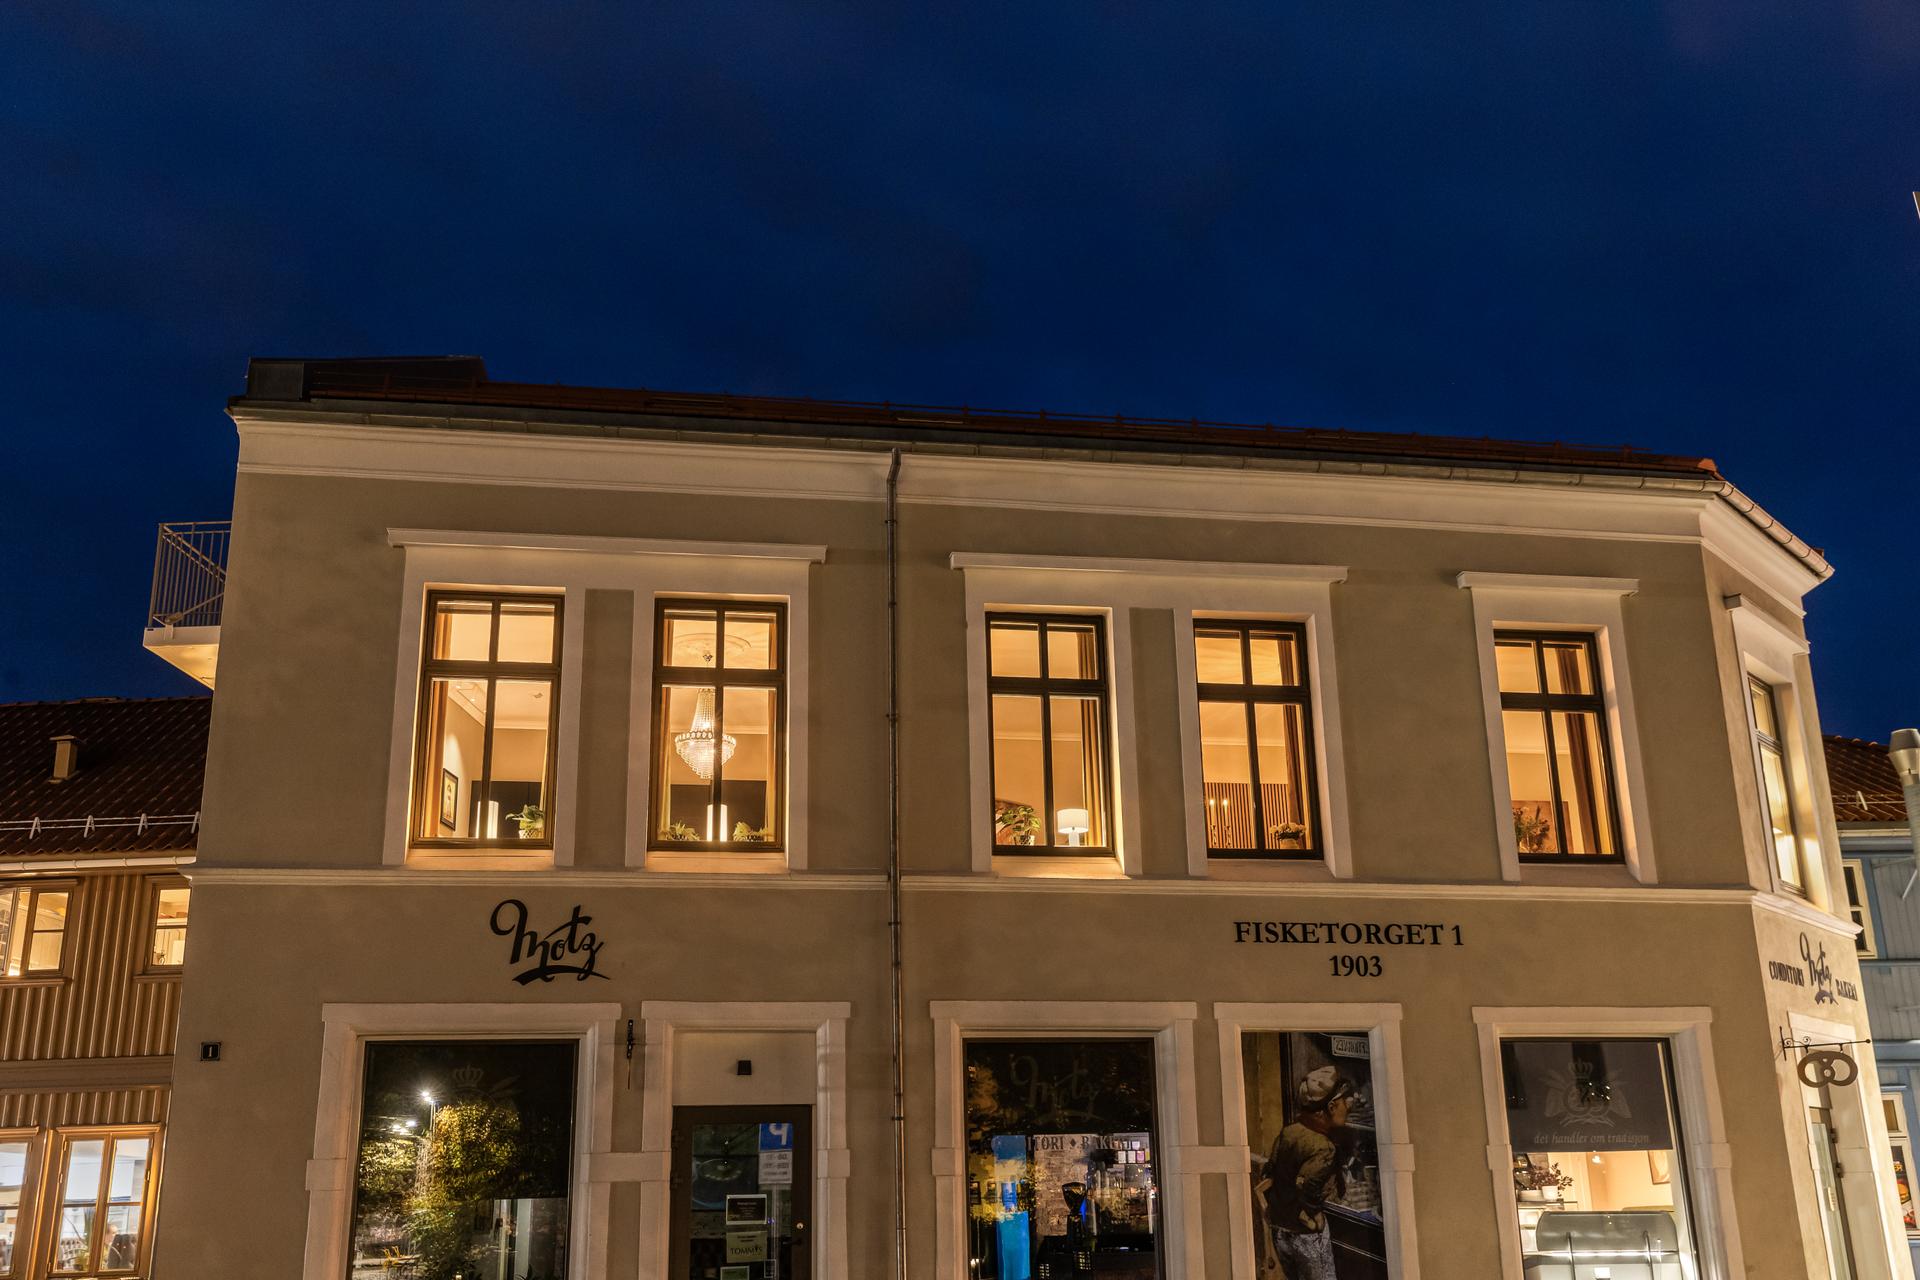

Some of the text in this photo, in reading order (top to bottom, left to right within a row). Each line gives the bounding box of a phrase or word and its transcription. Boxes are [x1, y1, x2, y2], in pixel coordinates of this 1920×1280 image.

[1233, 921, 1464, 946] FISKETORGET 1
[1329, 955, 1383, 977] 1903
[1769, 961, 1805, 987] CONDITORI
